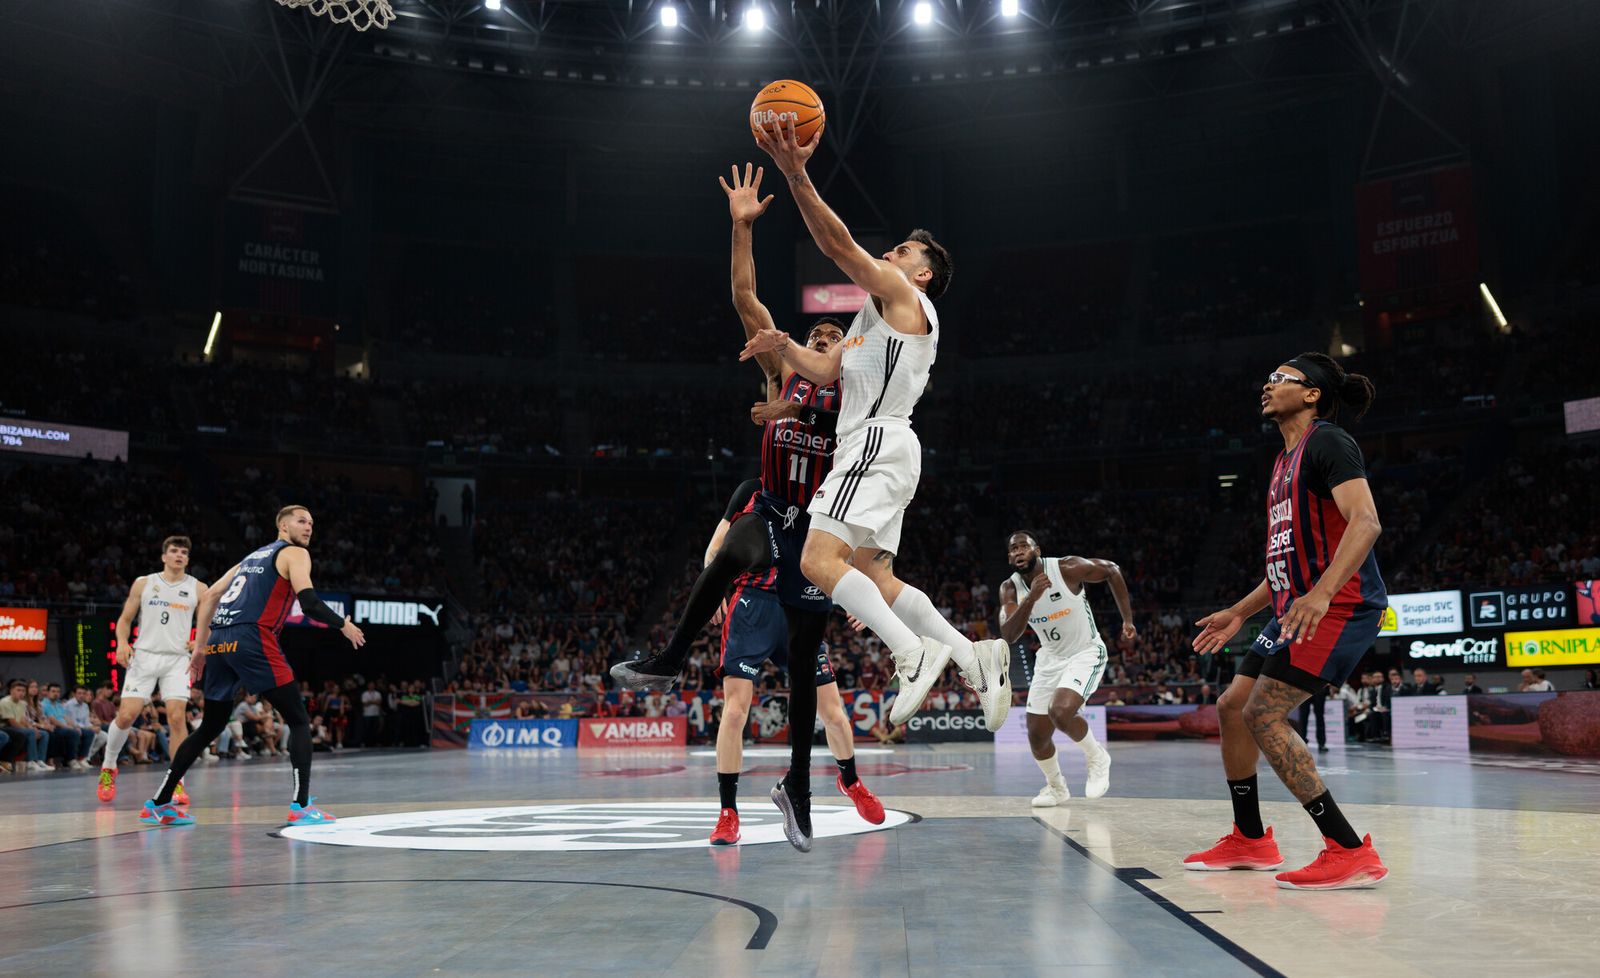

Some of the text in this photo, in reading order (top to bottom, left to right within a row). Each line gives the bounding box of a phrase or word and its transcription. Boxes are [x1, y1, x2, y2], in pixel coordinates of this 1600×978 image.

[1377, 211, 1453, 237] ESFUERZO
[1373, 228, 1458, 254] ESFORTZUA
[244, 241, 320, 264] CARÁCTER
[239, 258, 324, 281] NORTASUNA
[789, 454, 809, 484] 11
[1269, 528, 1293, 550] osner
[1267, 560, 1291, 592] 95
[220, 576, 247, 604] 8
[1507, 591, 1566, 606] GRUPO
[160, 611, 170, 625] 9
[354, 599, 419, 626] PUMA
[1402, 601, 1453, 614] Grupo SVC
[1507, 606, 1567, 621] REGUI
[1403, 615, 1454, 627] Seguridad
[1043, 627, 1061, 642] 16
[1409, 637, 1498, 659] ServiCort
[1463, 654, 1496, 664] SYSTEM
[506, 728, 563, 747] IMQ
[605, 721, 675, 739] AMBAR
